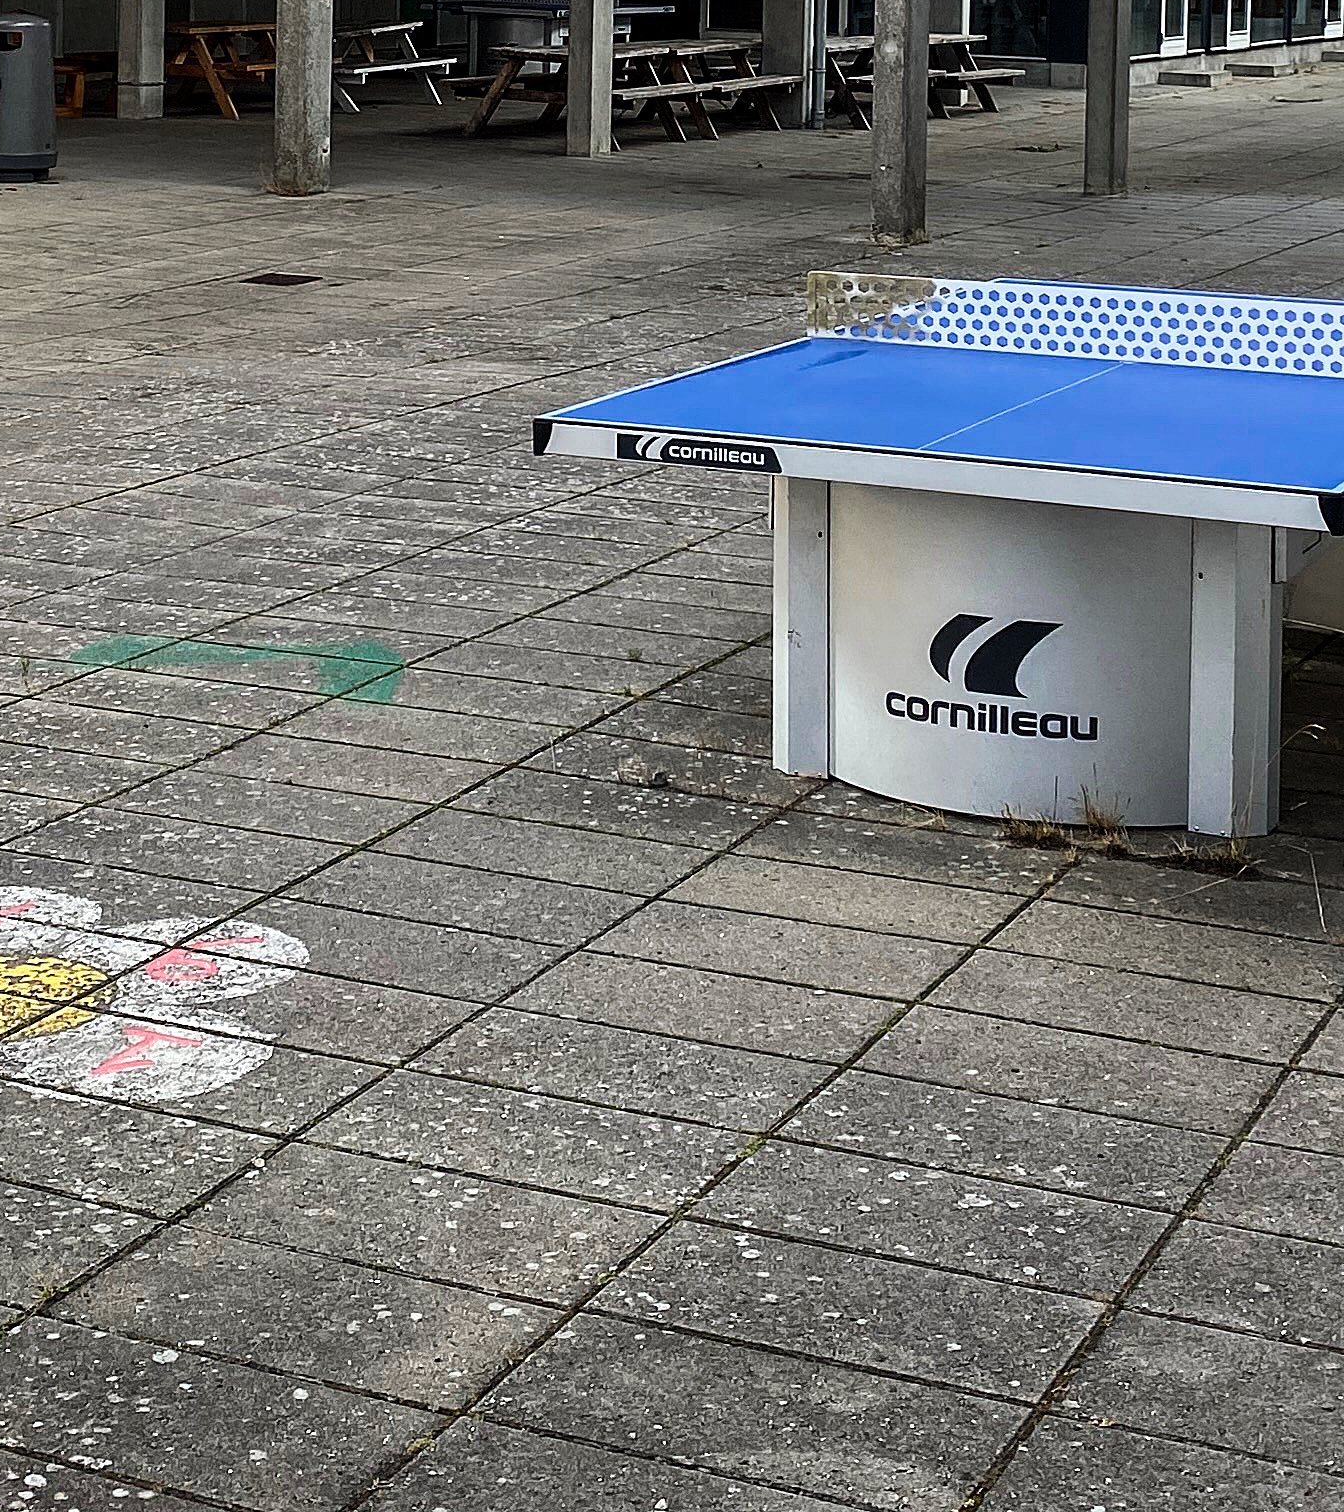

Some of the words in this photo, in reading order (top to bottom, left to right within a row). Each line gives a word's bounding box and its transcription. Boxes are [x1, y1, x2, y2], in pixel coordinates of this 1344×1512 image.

[668, 444, 766, 466] cornilleau
[885, 691, 1099, 741] cornilleau
[91, 1026, 204, 1076] 1
